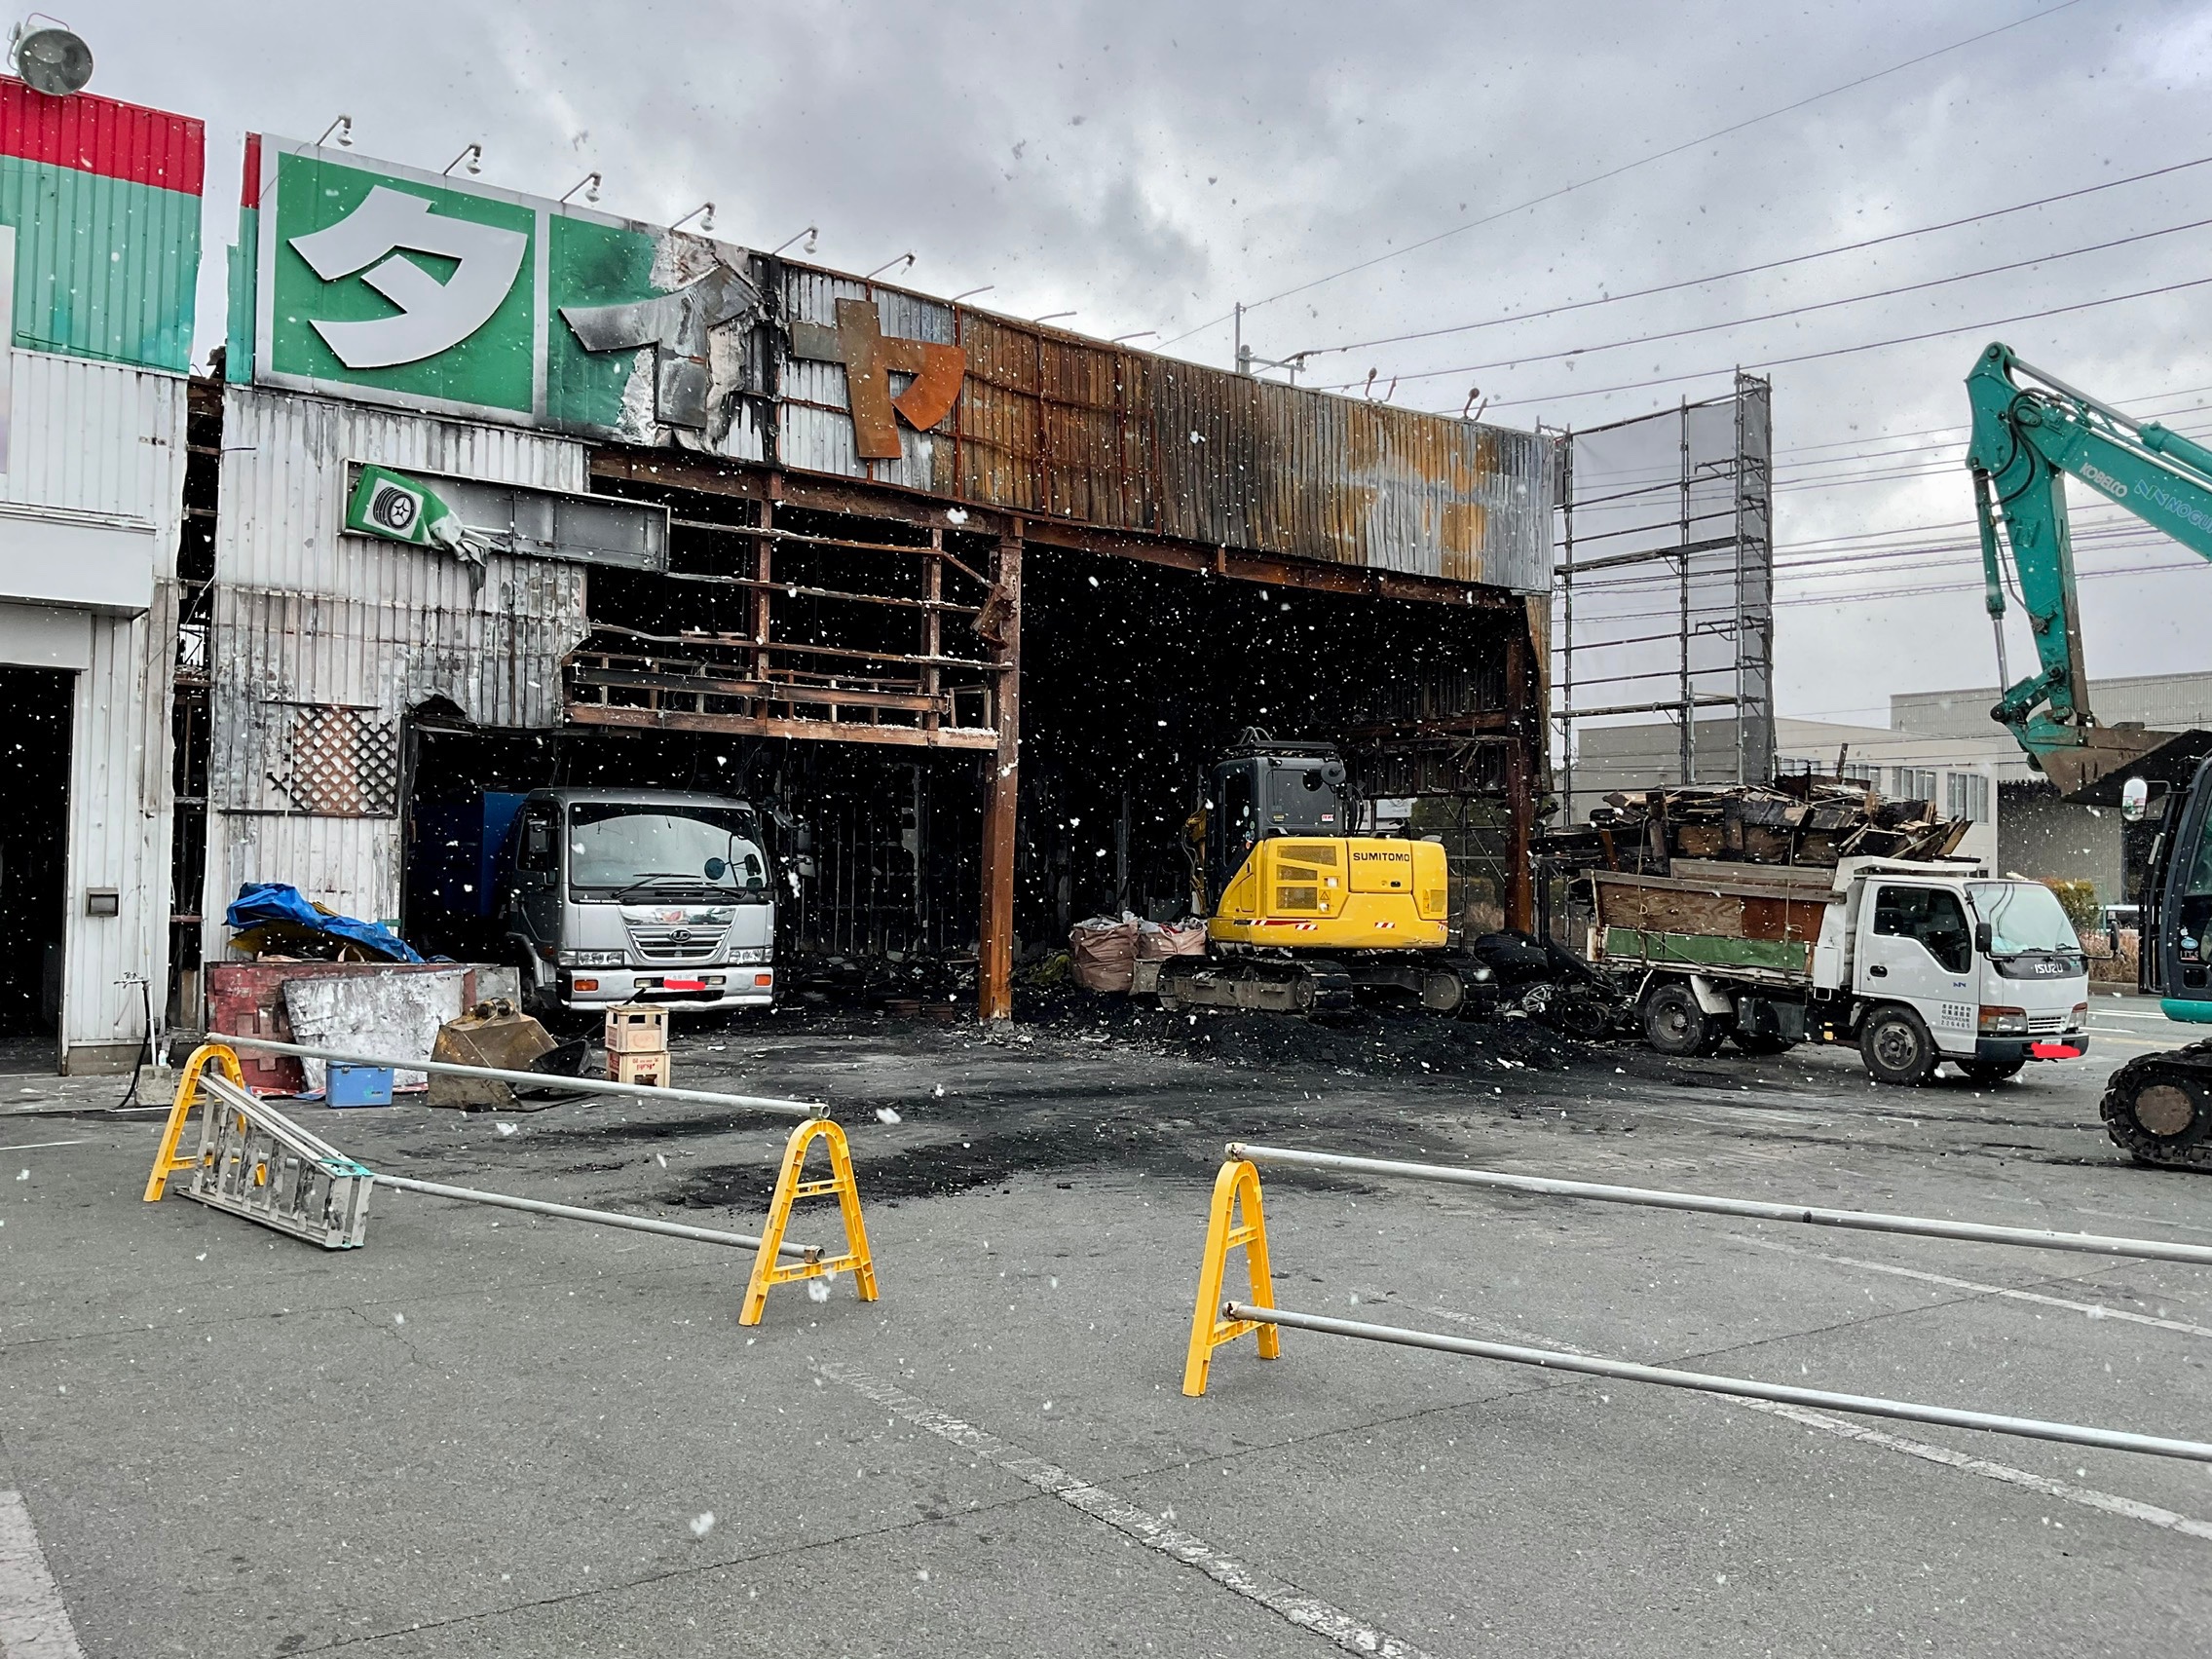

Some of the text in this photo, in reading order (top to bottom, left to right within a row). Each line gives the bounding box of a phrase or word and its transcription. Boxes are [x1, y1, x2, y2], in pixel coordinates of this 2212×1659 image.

[2079, 462, 2128, 498] KOBELCO
[1353, 852, 1410, 862] SUMITOMO
[2034, 962, 2064, 974] ISUZU
